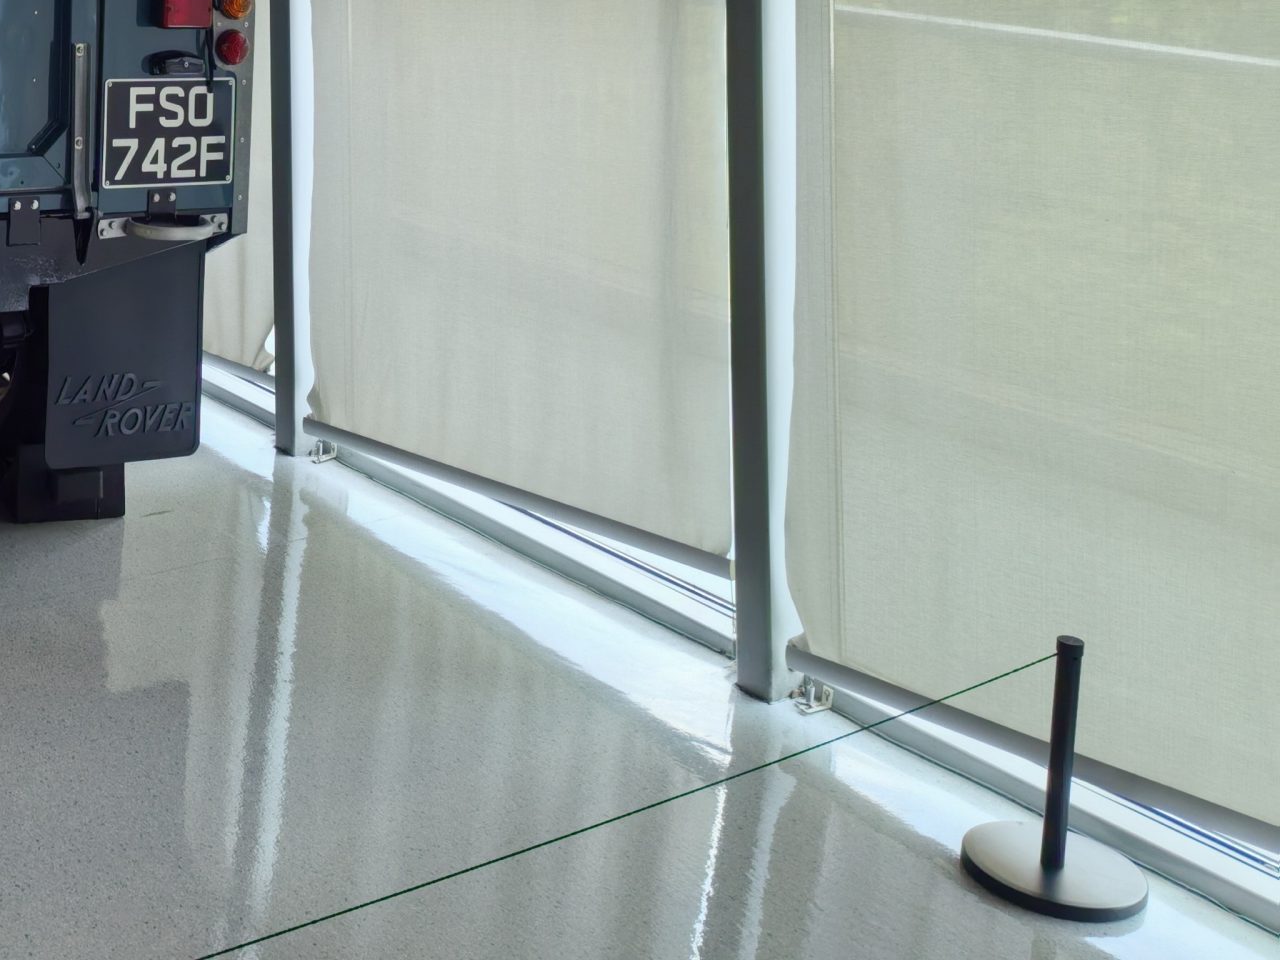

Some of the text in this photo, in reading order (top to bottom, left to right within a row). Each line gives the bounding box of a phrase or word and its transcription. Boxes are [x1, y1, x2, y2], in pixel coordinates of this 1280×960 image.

[129, 85, 214, 129] FSO
[112, 136, 226, 181] 742F
[54, 373, 138, 406] LAND
[93, 401, 194, 438] ROVER
